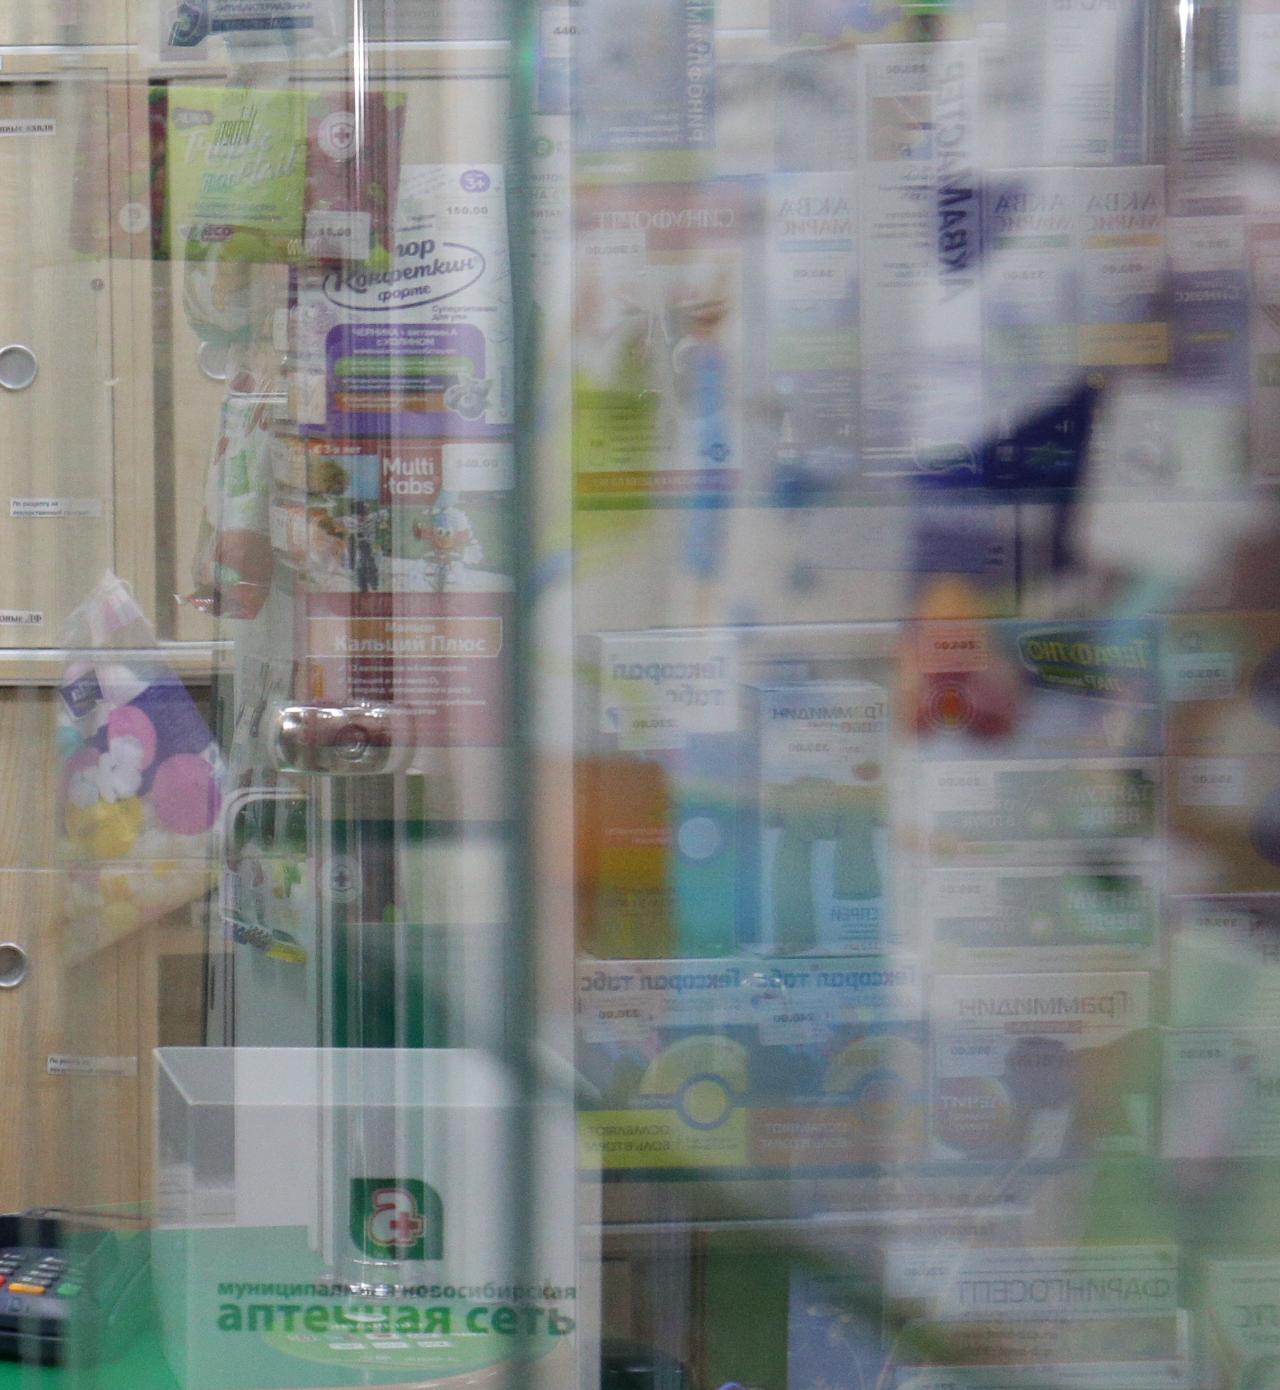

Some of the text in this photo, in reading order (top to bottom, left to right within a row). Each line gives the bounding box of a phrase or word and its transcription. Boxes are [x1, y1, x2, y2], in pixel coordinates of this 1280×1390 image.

[377, 284, 433, 303] форте
[381, 457, 434, 475] Multi
[431, 635, 486, 652] Плюс
[217, 1278, 578, 1300] муниципальная новосибирская
[216, 1304, 577, 1337] аптечная сеть
